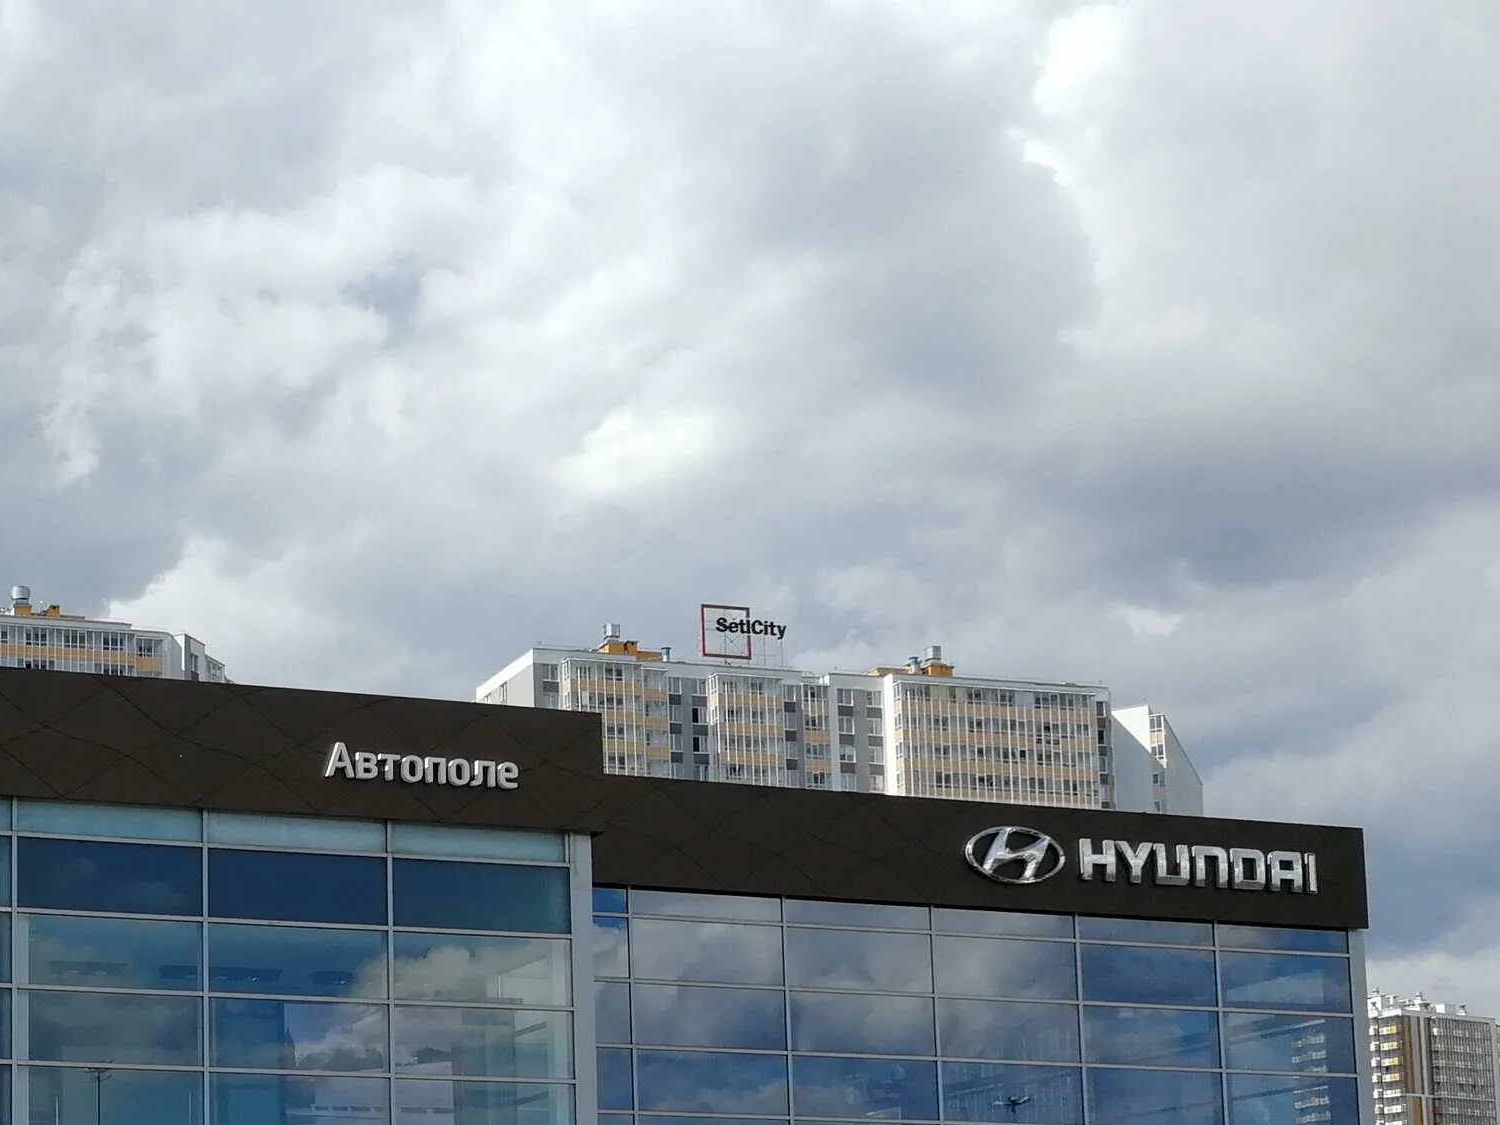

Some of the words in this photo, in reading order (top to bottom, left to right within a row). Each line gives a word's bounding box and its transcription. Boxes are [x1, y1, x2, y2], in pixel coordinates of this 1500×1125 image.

[716, 617, 787, 640] SetlCity
[323, 741, 519, 789] Автополе
[1078, 838, 1318, 895] HYUNDAI
